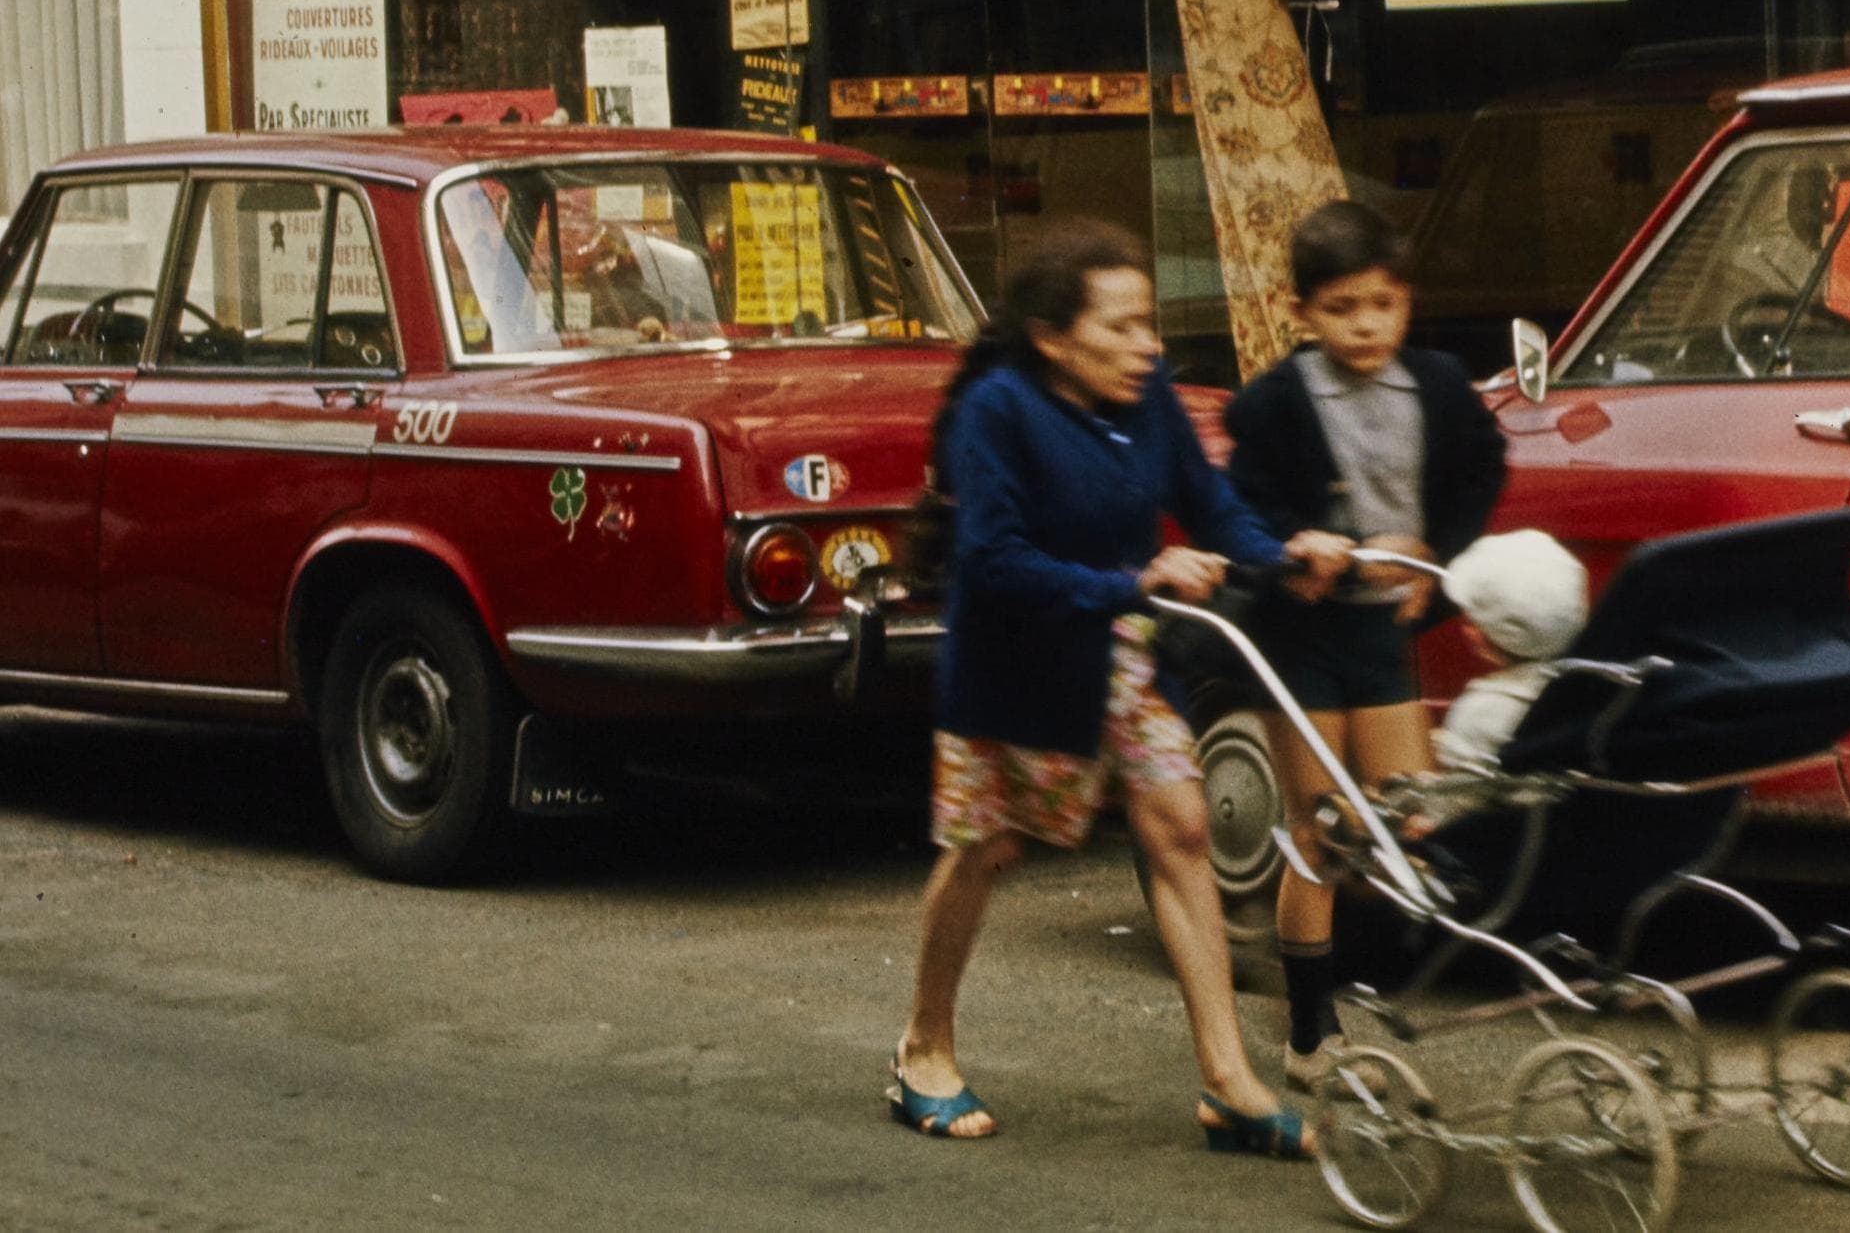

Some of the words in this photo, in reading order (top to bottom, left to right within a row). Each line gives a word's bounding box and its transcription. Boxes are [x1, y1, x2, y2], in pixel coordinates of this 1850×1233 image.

[287, 4, 374, 29] COUVERTURES
[259, 101, 284, 129] PAR
[392, 400, 458, 444] 500
[808, 460, 826, 497] F
